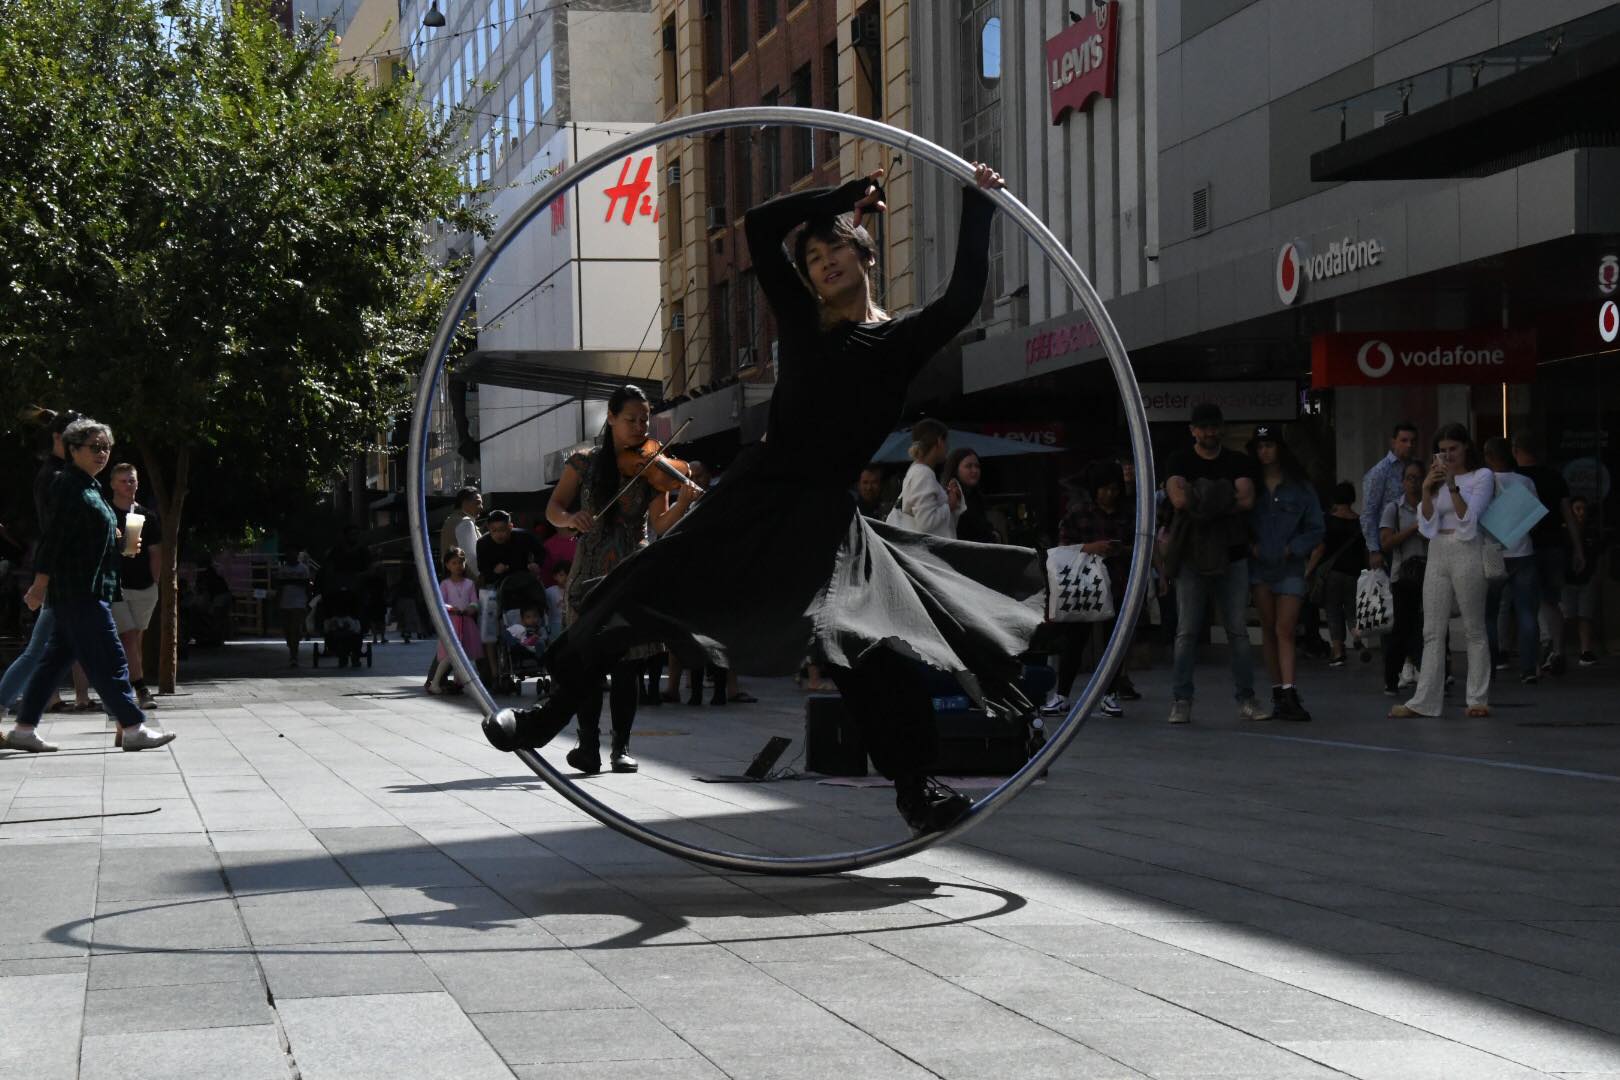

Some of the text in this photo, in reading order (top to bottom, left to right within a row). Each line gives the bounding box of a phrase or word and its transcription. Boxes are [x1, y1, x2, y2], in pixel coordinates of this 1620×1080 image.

[603, 156, 659, 225] H&
[1305, 237, 1378, 281] vodafone
[1400, 345, 1505, 367] vodafone
